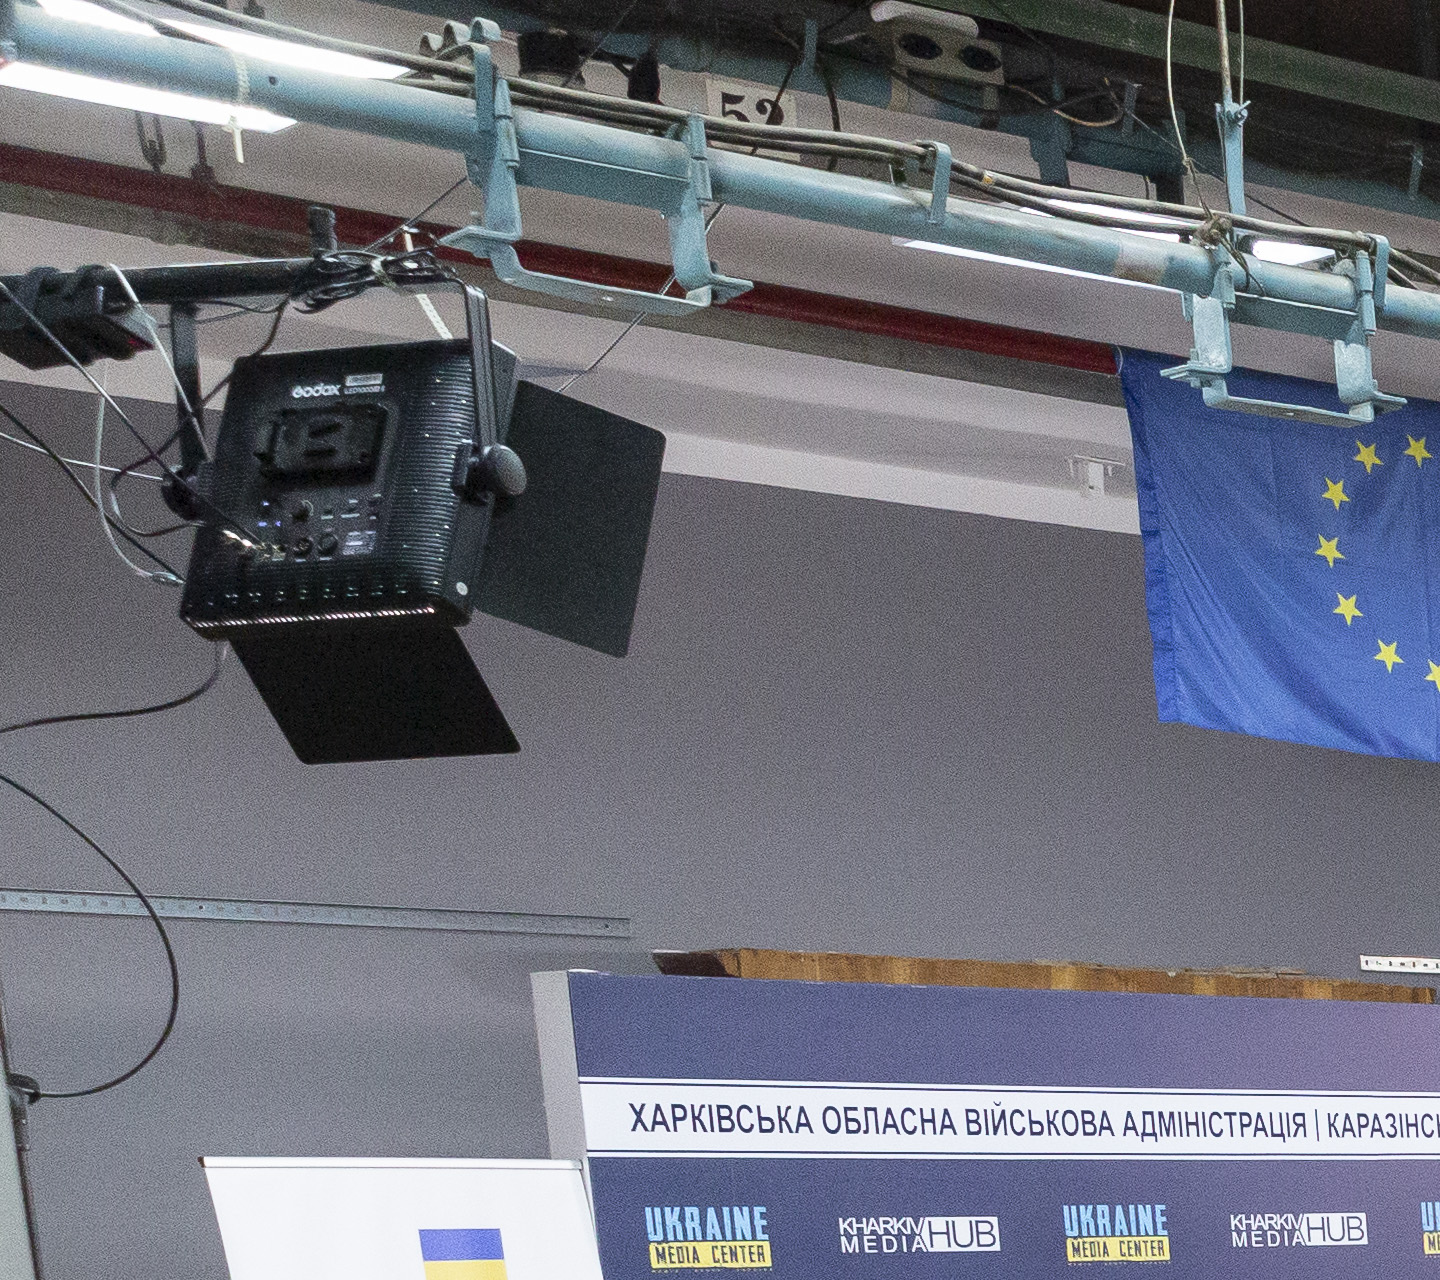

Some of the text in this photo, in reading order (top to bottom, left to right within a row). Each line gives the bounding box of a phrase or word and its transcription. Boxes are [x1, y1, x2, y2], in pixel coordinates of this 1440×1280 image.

[628, 1102, 814, 1135] ХАРКІВСЬКА
[822, 1105, 958, 1136] ОБЛАСНА
[966, 1101, 1115, 1138] ВІЙСЬКОВА
[1123, 1110, 1307, 1142] АДМІНІСТРАЦІЯ
[643, 1206, 770, 1242] UKRAINE
[838, 1216, 928, 1235] KHARKIV
[1062, 1202, 1169, 1236] UKRAINE
[1230, 1213, 1306, 1230] KHARKIV
[1231, 1216, 1365, 1247] MEDIA HUB
[840, 1219, 997, 1253] MEDIA HUB
[1071, 1238, 1166, 1257] MEDIA CENTER
[654, 1244, 767, 1265] MEDIA CENTER
